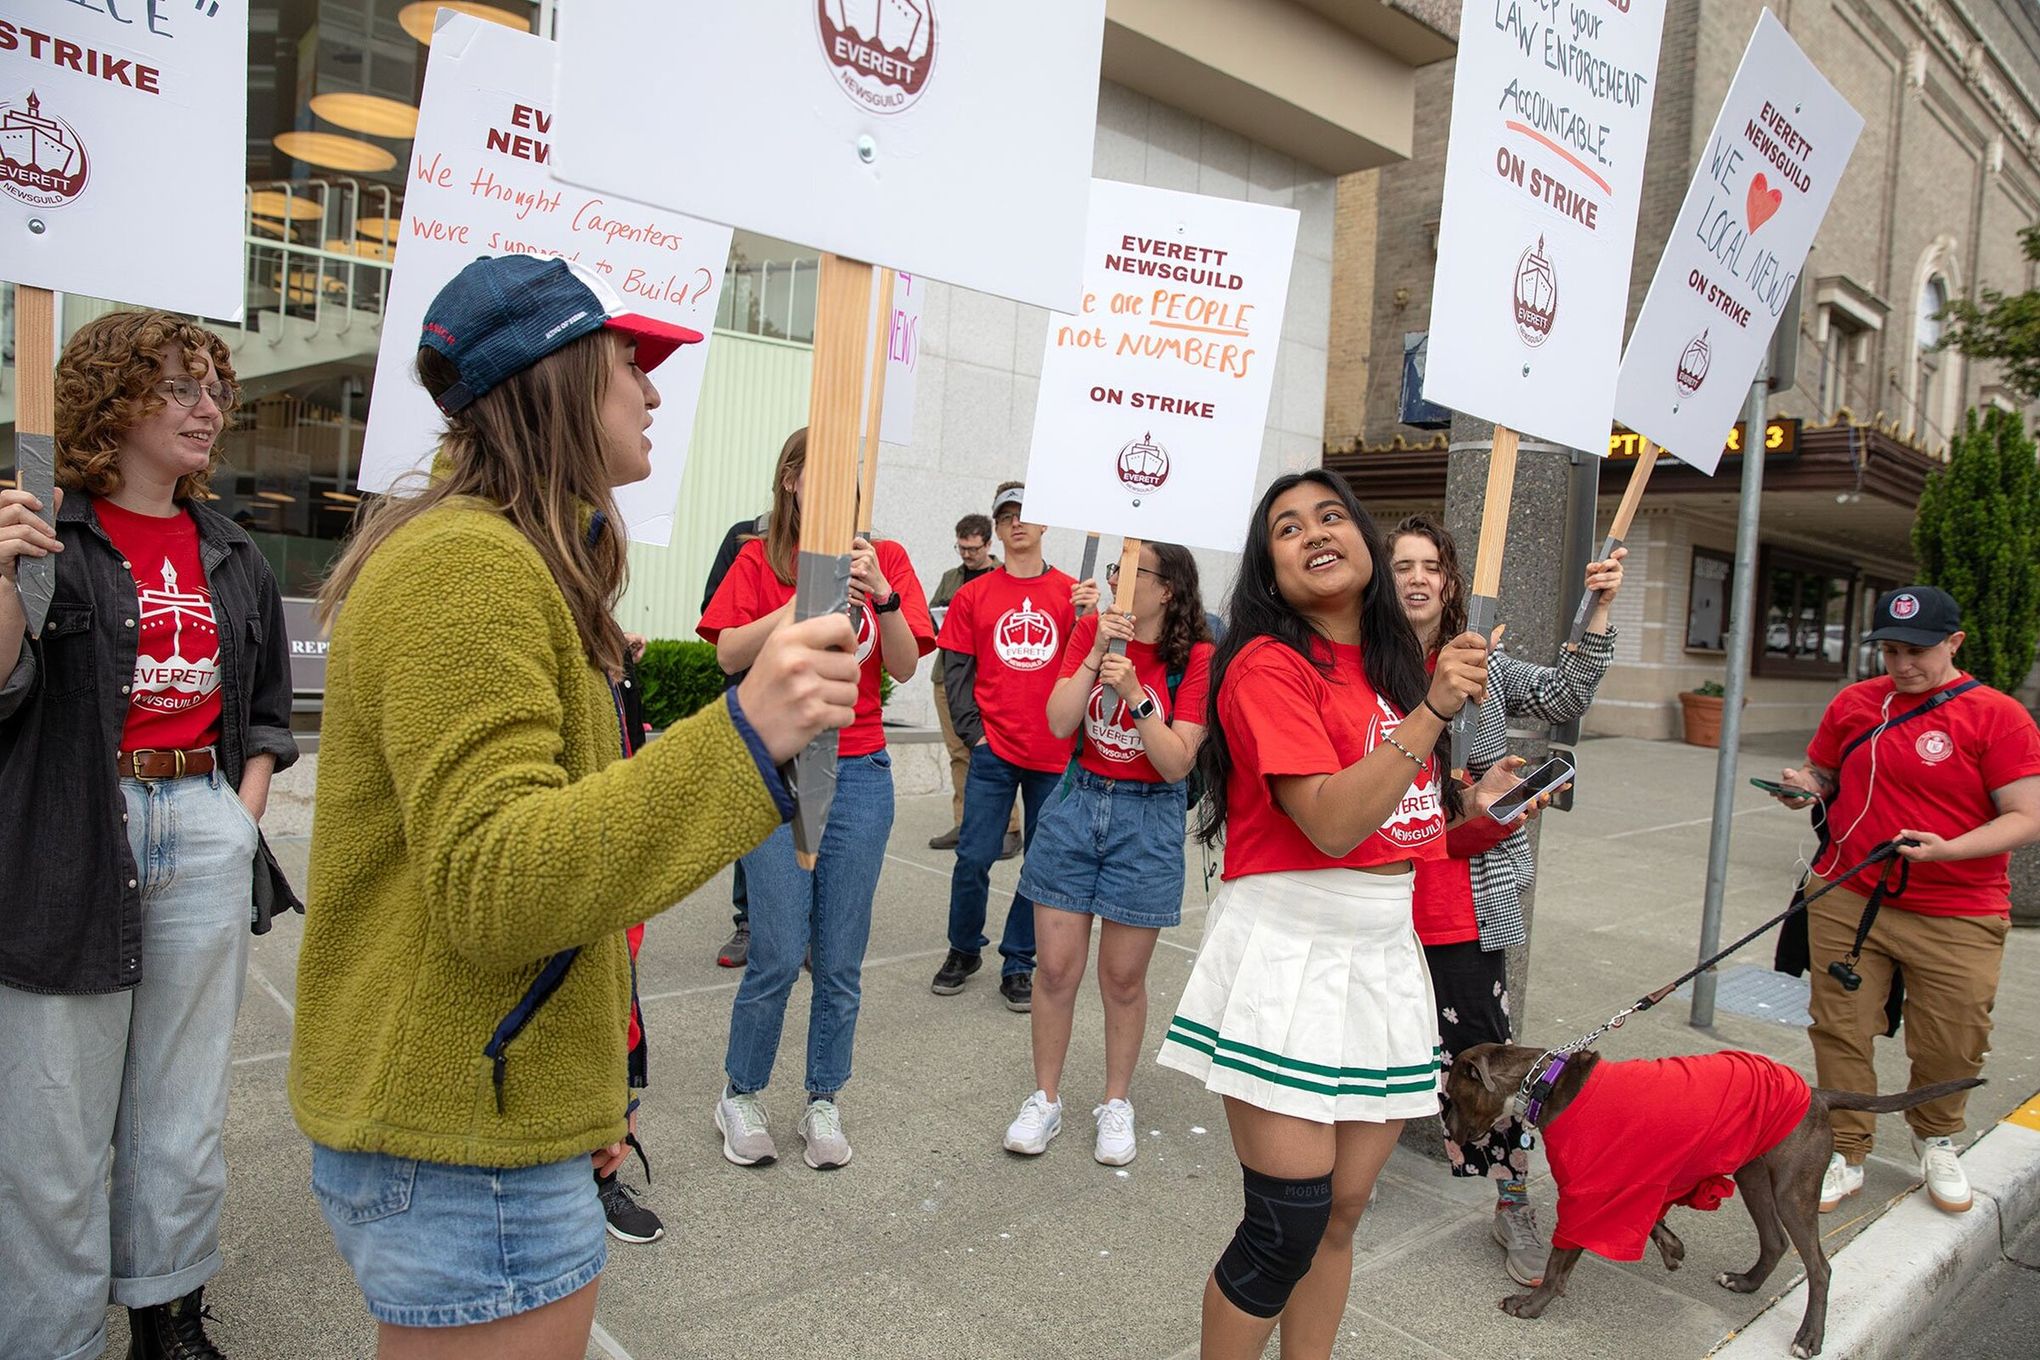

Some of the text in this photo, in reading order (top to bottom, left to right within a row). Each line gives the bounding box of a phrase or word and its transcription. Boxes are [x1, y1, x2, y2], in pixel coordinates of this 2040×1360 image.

[1570, 2, 1604, 42] your
[0, 19, 160, 95] STRIKE
[834, 36, 916, 84] EVERETT
[1495, 0, 1648, 109] LAW ENFORCEMENT
[841, 70, 905, 107] NEWSGUILD
[1759, 100, 1814, 162] EVERETT
[0, 163, 71, 191] EVERETT
[1710, 135, 1745, 196] WE
[1743, 118, 1812, 194] NEWSGUILD
[3, 182, 63, 204] NEWSGUILD
[416, 152, 683, 251] We thought Carpenters
[1496, 146, 1599, 231] ON STRIKE
[1104, 254, 1245, 291] NEWSGUILD
[1121, 234, 1229, 267] EVERETT
[1696, 195, 1796, 318] LOCAL NEWS
[595, 258, 613, 275] to
[621, 266, 713, 312] Build?
[1688, 268, 1752, 328] ON STRIKE
[1110, 292, 1145, 316] are
[1150, 289, 1256, 331] PEOPLE
[1056, 326, 1256, 379] not NUMBERS
[1090, 386, 1216, 419] ON STRIKE
[1764, 425, 1784, 449] 3
[1122, 472, 1161, 485] EVERETT
[291, 640, 331, 655] REP
[1006, 646, 1047, 657] EVERETT
